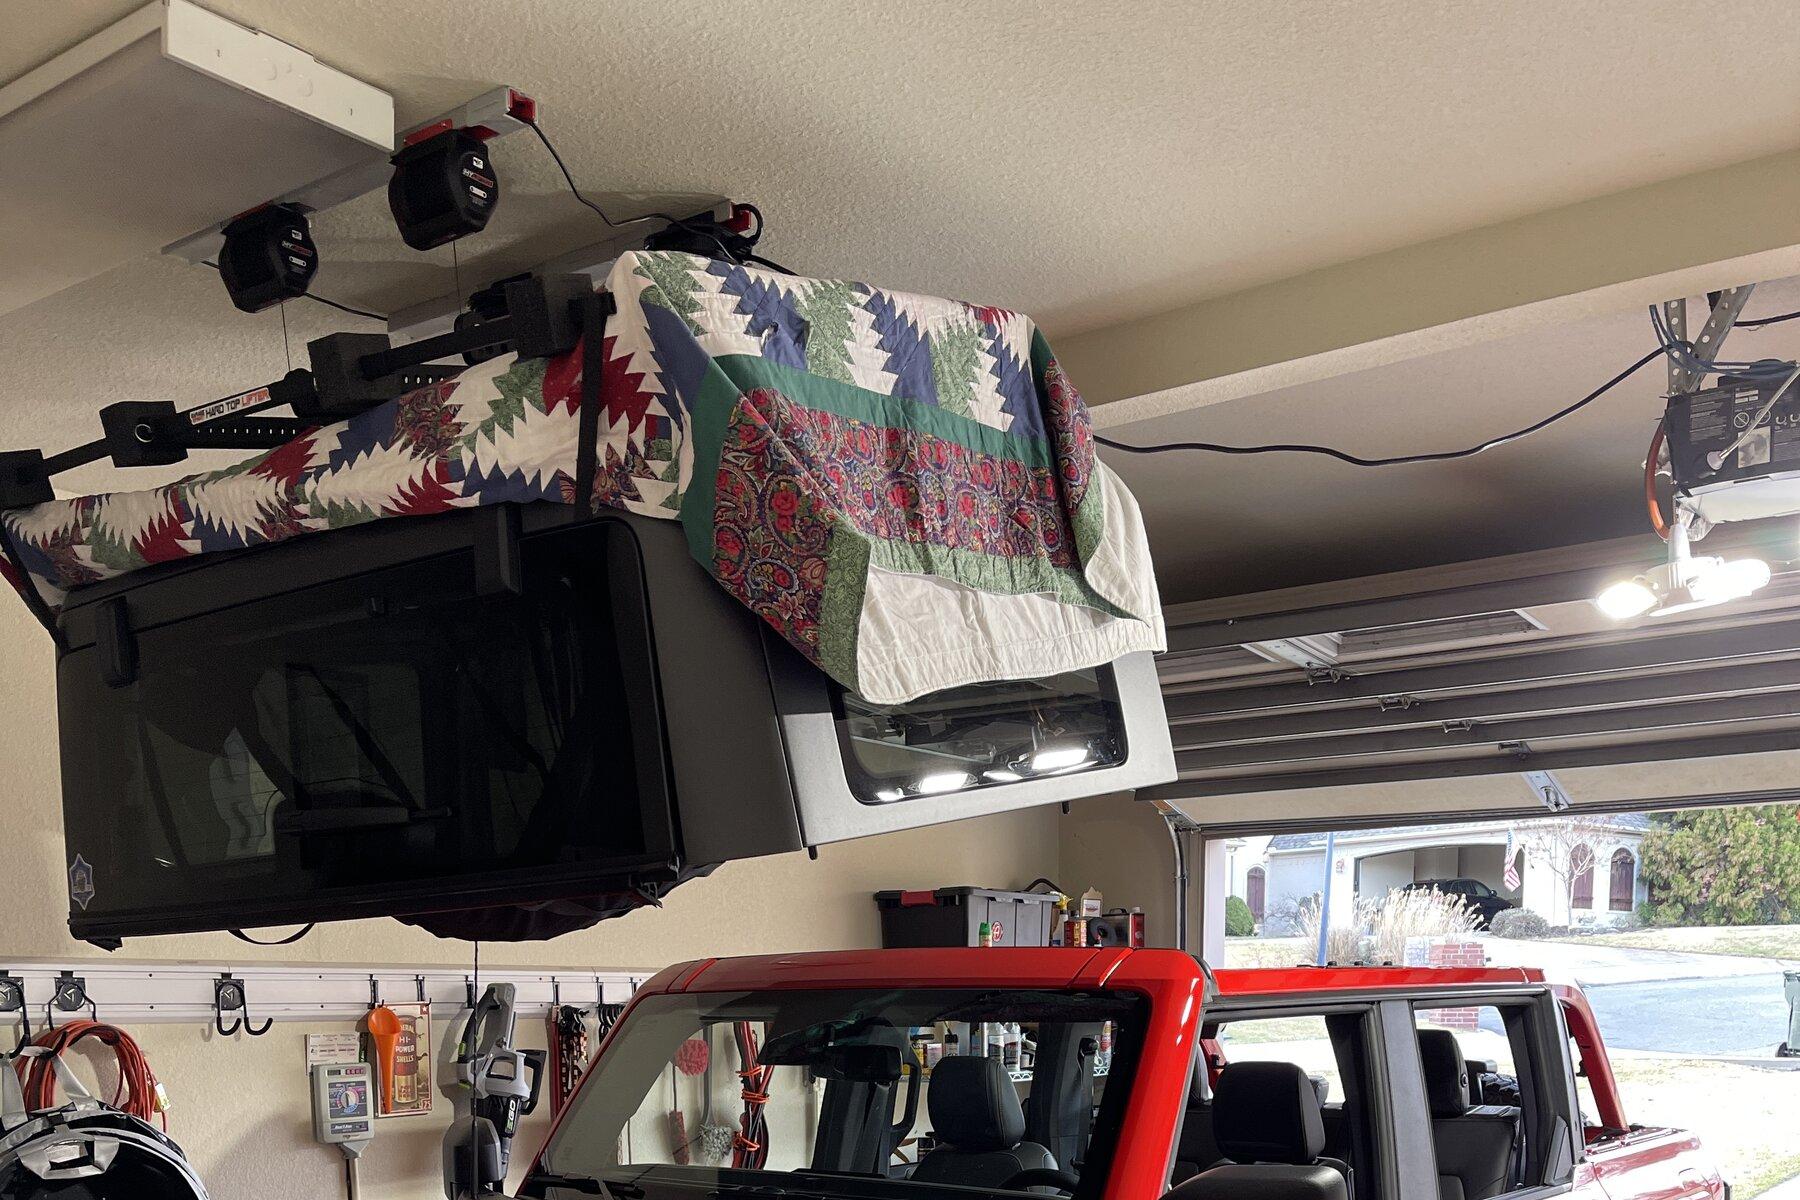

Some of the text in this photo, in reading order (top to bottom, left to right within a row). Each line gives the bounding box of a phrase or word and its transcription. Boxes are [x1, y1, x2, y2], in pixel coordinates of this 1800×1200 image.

[205, 404, 224, 418] HARD
[225, 399, 240, 412] TOP
[395, 1044, 415, 1053] POWER
[506, 1100, 516, 1131] EGO
